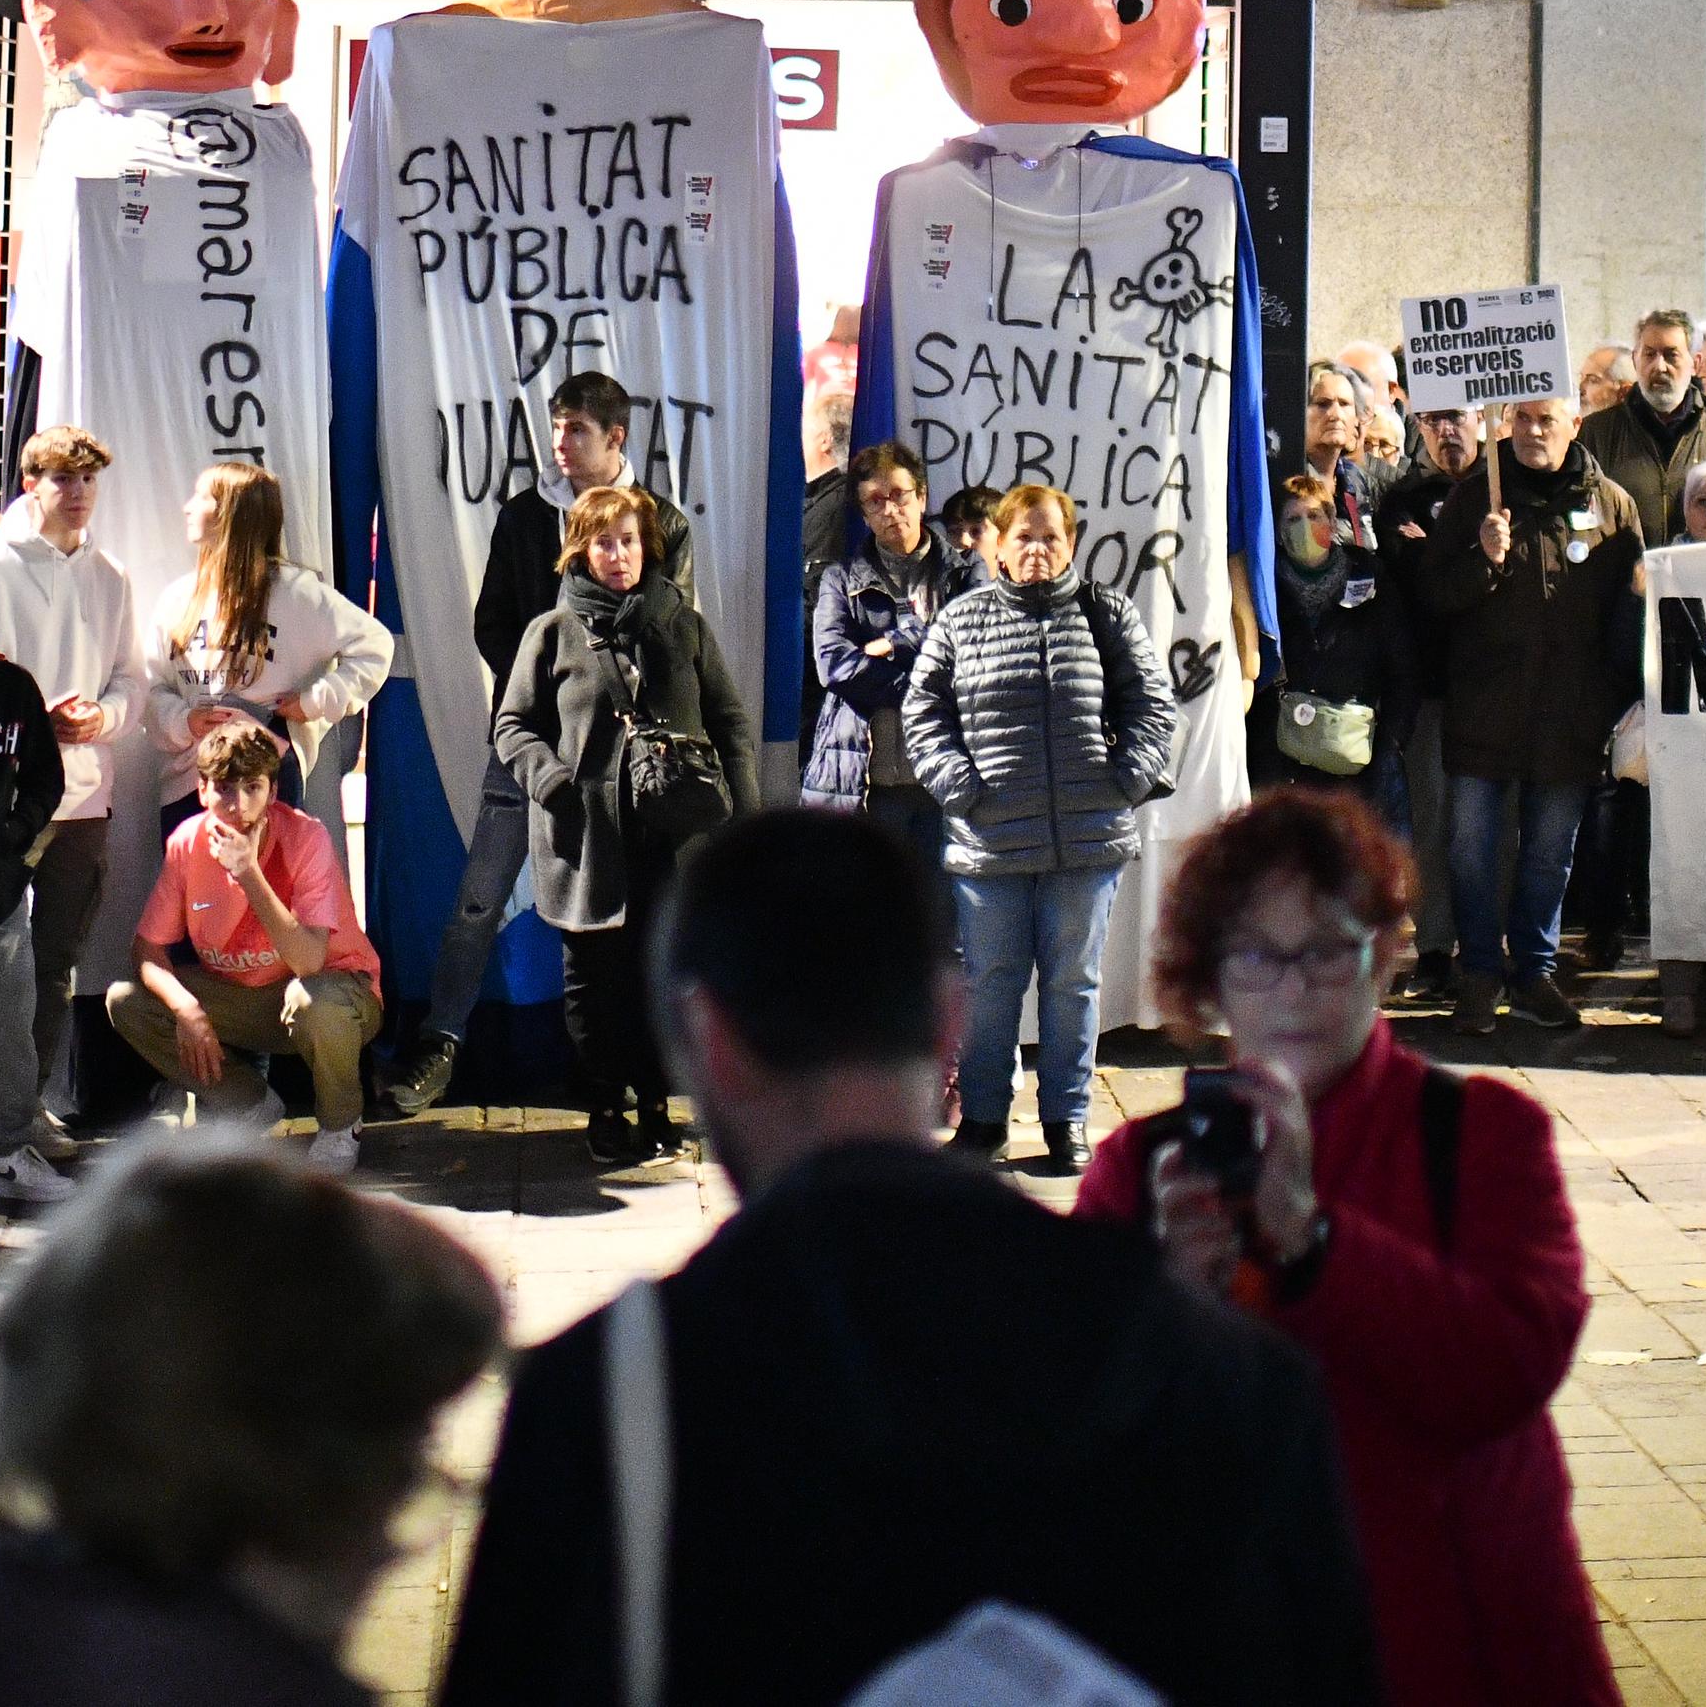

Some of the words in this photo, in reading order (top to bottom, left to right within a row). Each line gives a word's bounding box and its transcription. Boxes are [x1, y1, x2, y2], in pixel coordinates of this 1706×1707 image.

[997, 243, 1097, 334] LA
[1419, 297, 1468, 333] no
[1410, 319, 1556, 354] externalització
[1412, 358, 1433, 375] de
[1435, 345, 1524, 377] serveis
[1465, 371, 1554, 403] públics
